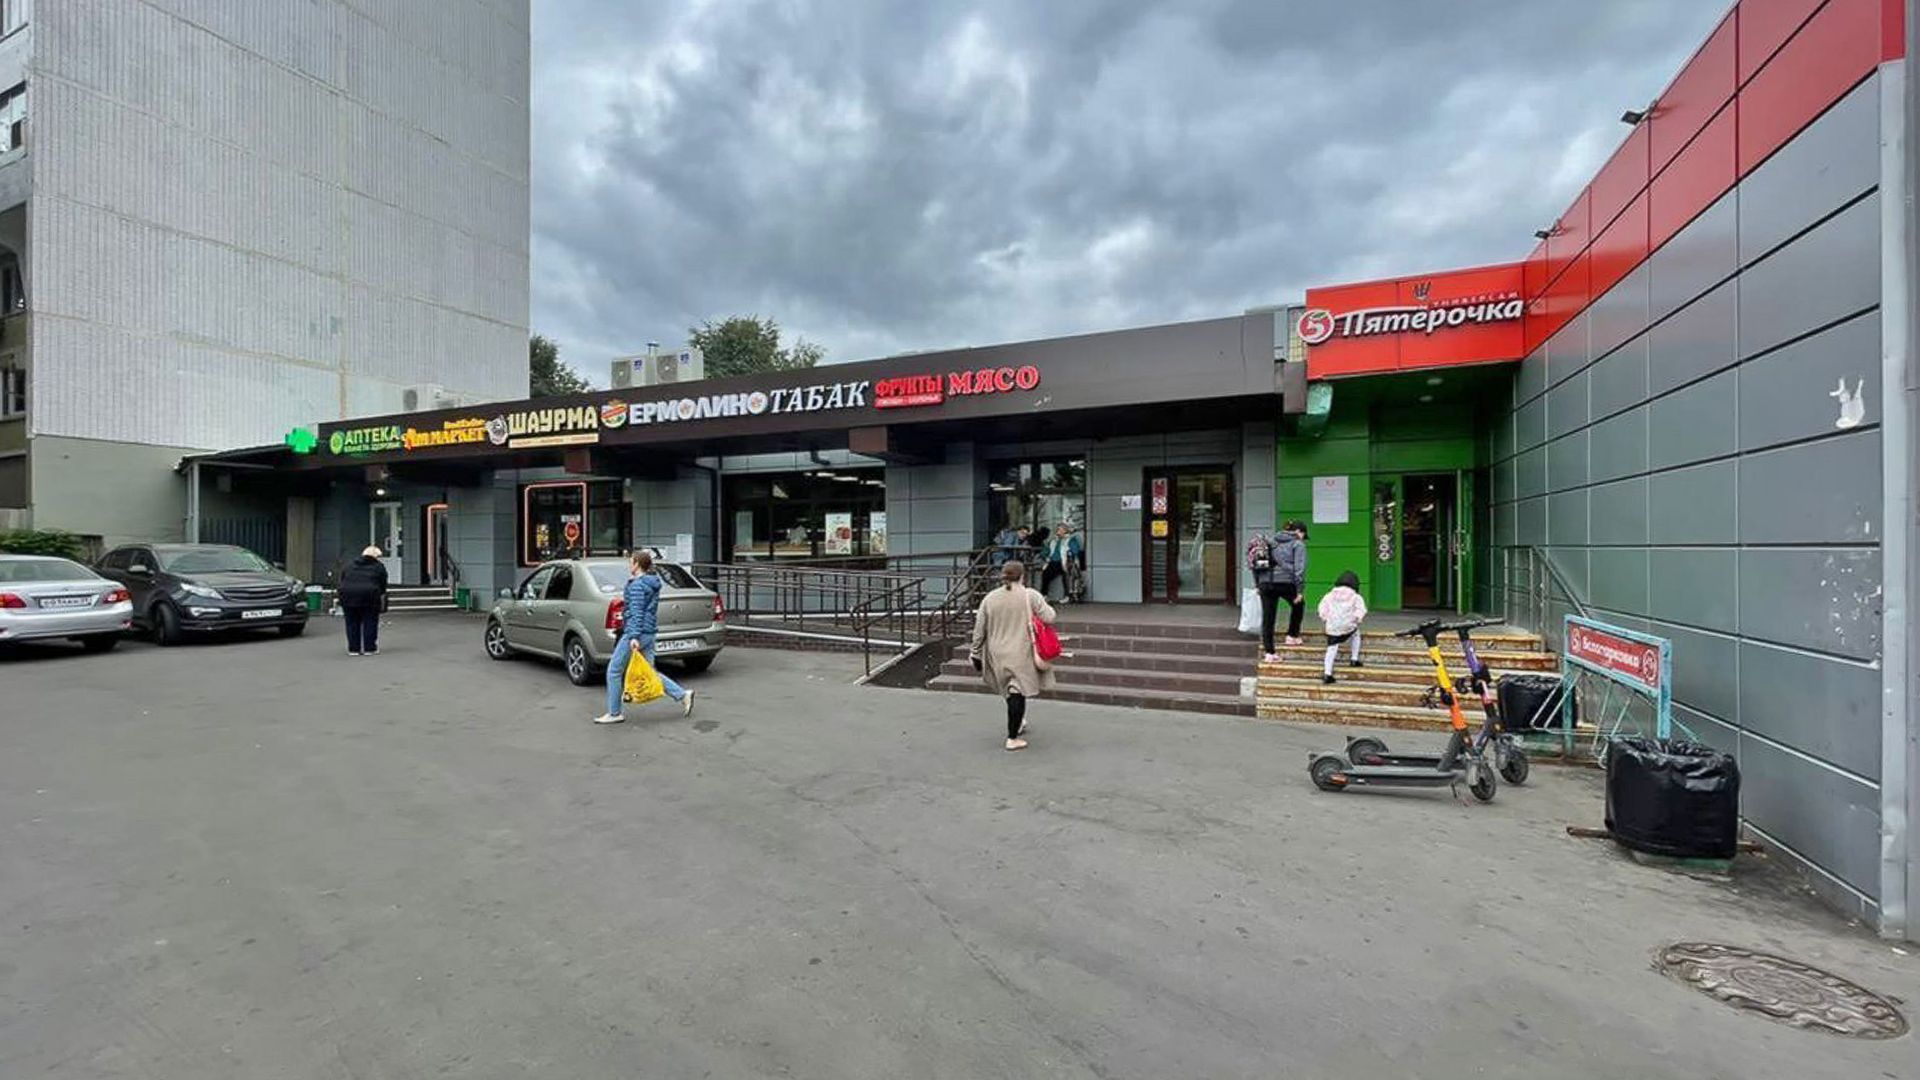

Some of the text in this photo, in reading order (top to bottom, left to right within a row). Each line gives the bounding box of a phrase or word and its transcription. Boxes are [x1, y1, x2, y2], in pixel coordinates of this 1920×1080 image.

[874, 375, 942, 396] ФРУКТЫ
[948, 365, 1040, 396] МЯСО
[629, 391, 768, 425] ЕРМОЛИНО
[770, 381, 869, 414] ТАБАК
[344, 426, 400, 445] АПТЕКА
[507, 406, 598, 436] ШАУРМА
